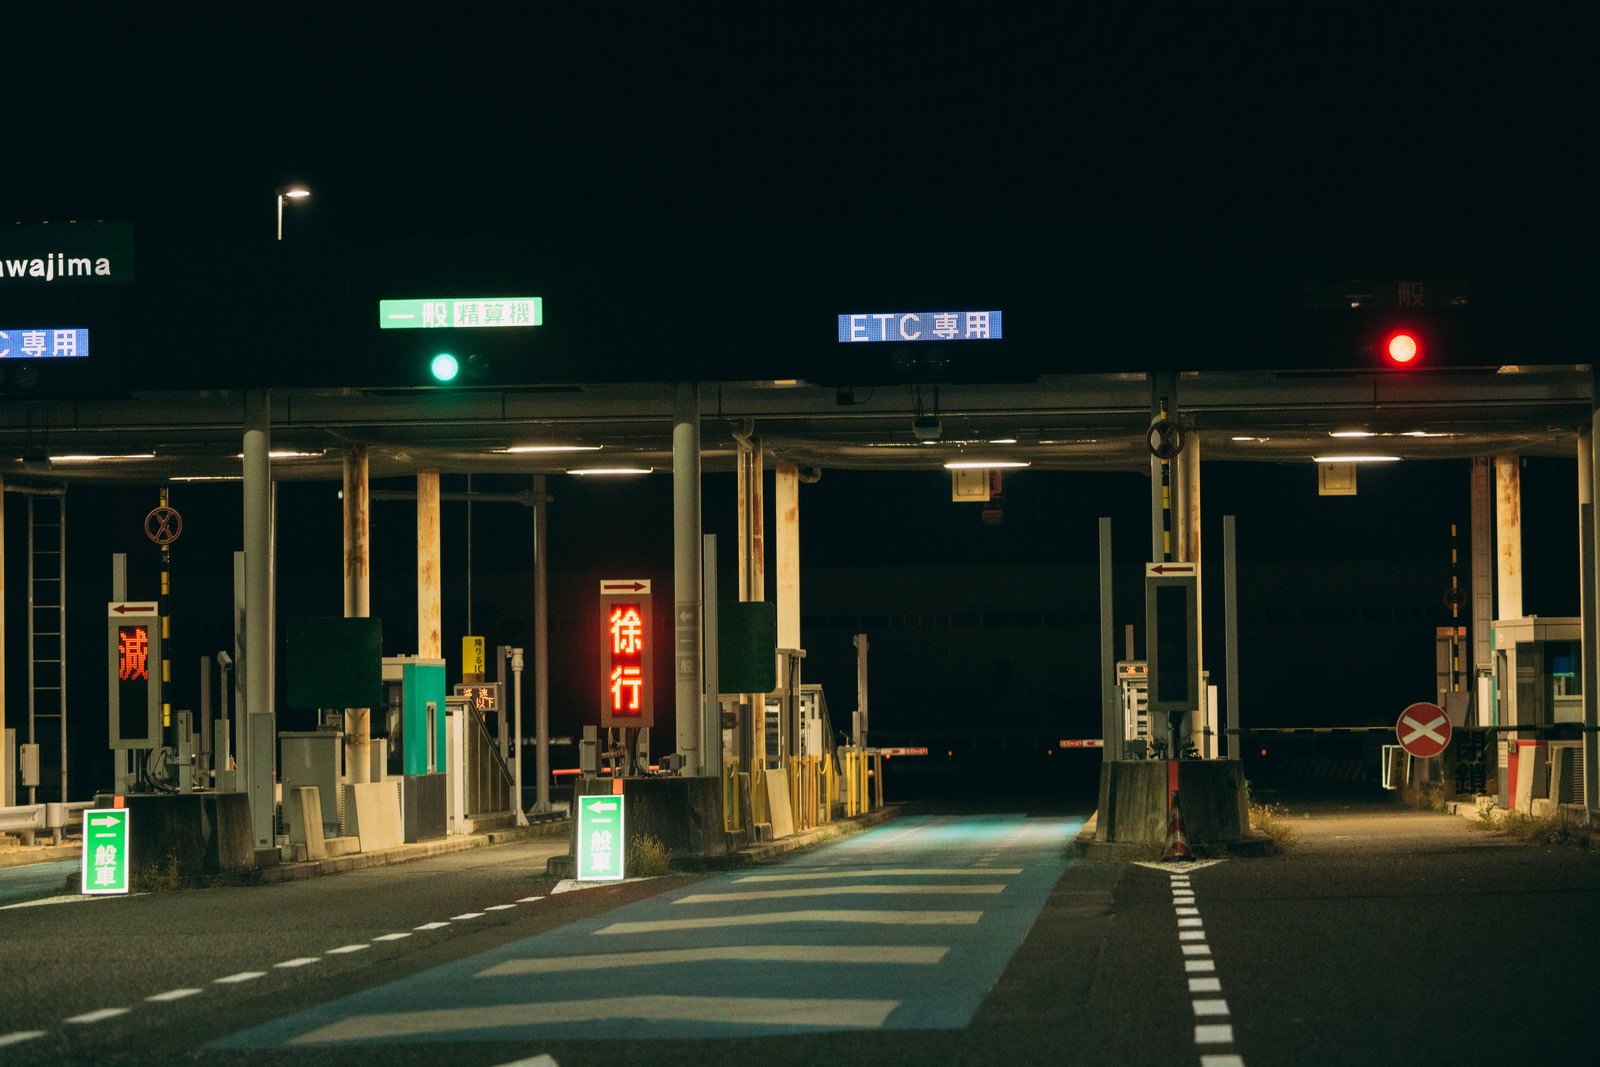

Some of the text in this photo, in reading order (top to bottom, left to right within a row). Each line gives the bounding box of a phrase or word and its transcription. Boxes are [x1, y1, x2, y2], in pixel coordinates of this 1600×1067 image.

[0, 253, 111, 281] wajima
[118, 627, 148, 680] 減
[611, 609, 642, 710] 徐行
[95, 833, 117, 887] 一般車
[591, 818, 612, 872] 一般車
